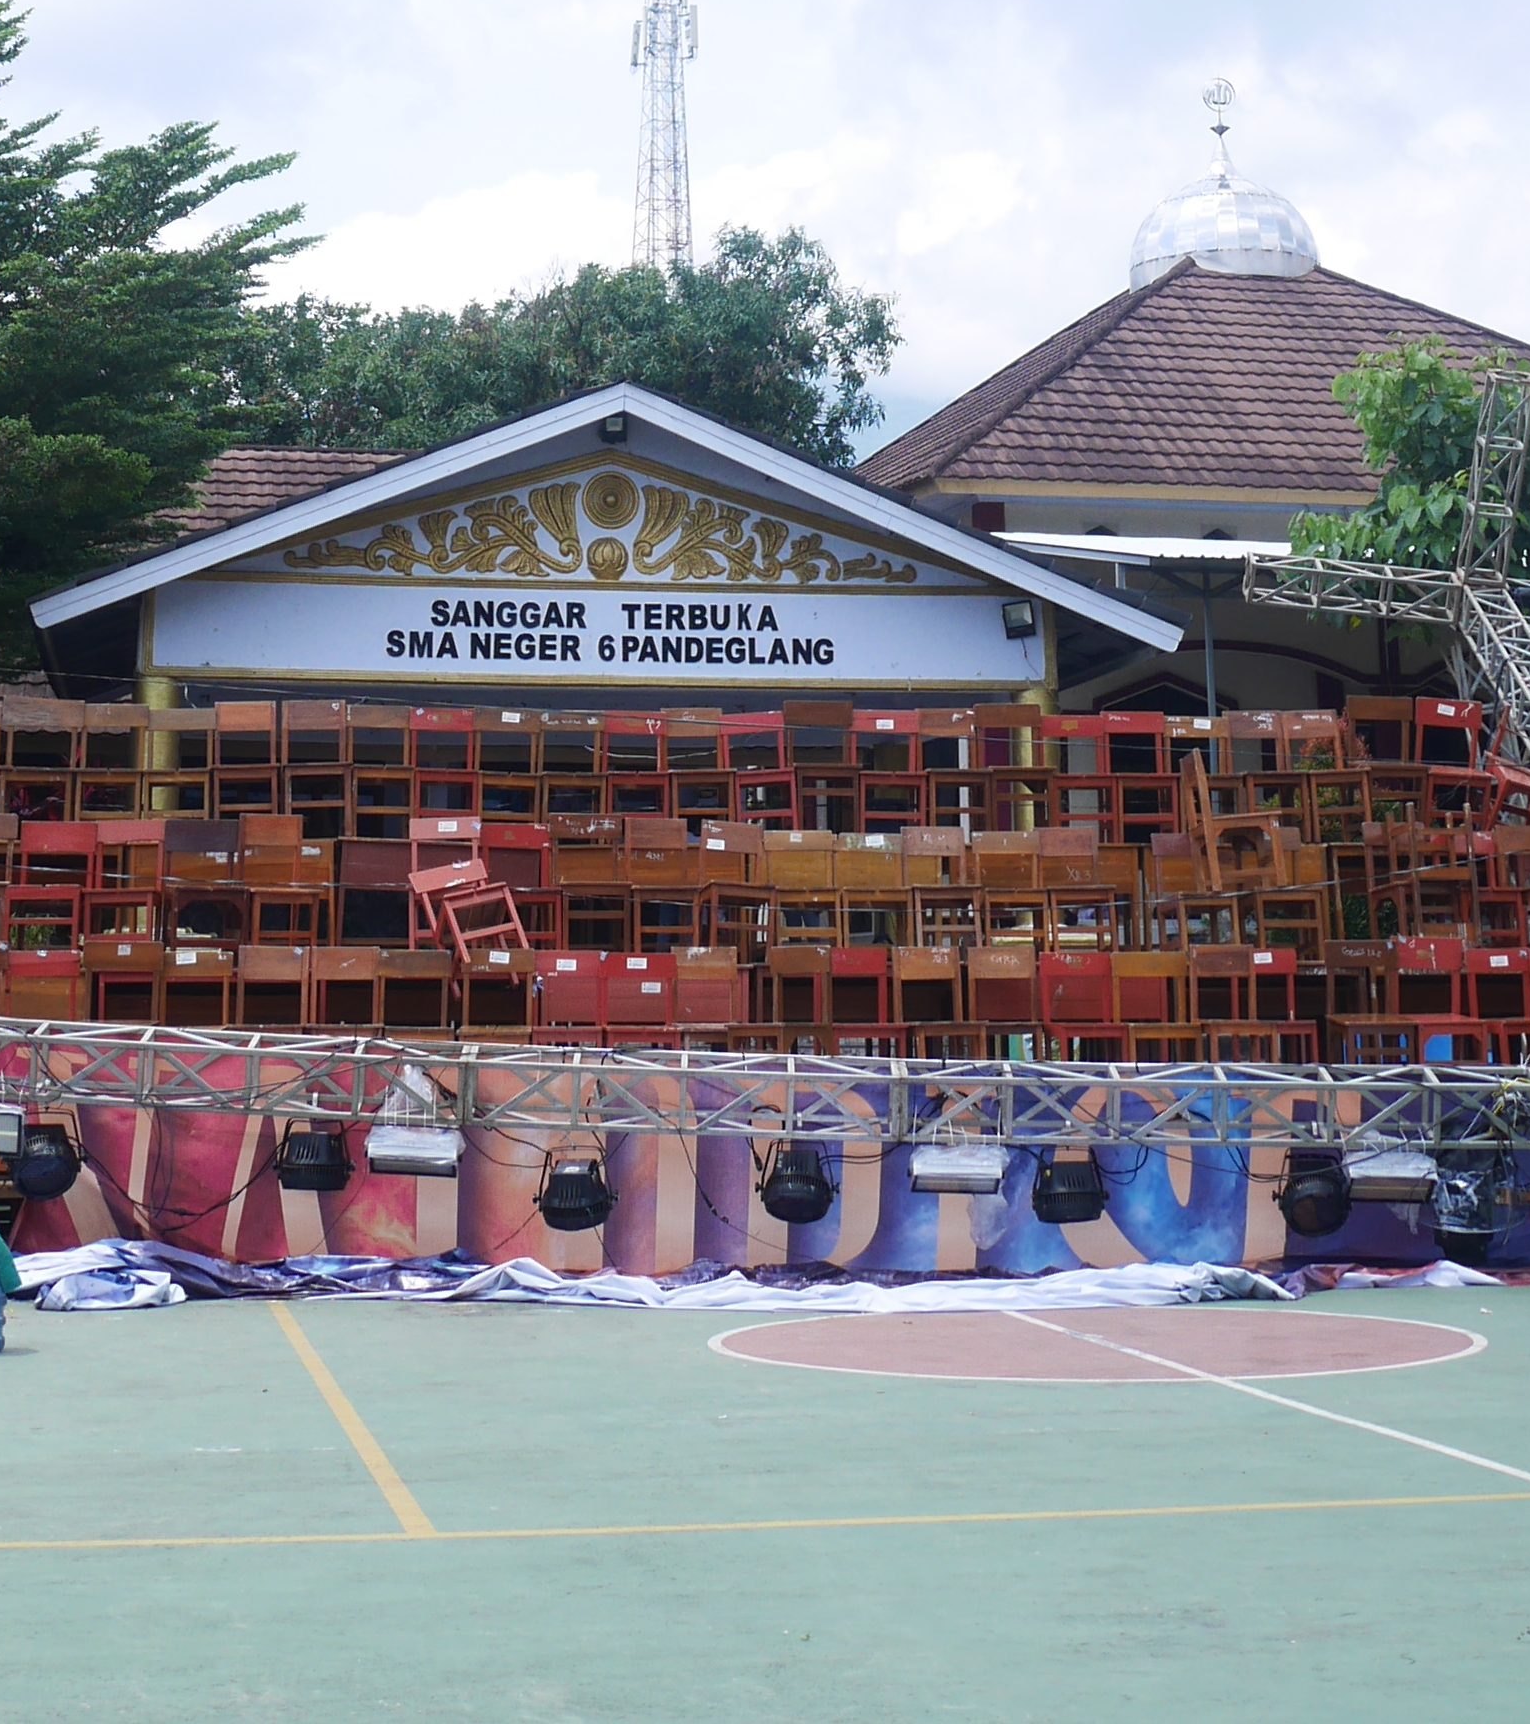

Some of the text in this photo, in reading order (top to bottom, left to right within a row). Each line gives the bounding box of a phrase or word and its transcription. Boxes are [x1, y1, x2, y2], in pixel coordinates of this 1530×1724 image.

[430, 599, 779, 632] SANGGAR TERBUKA
[386, 629, 459, 660] SMA
[470, 632, 581, 662] NEGER
[621, 635, 834, 666] PANDEGLANG
